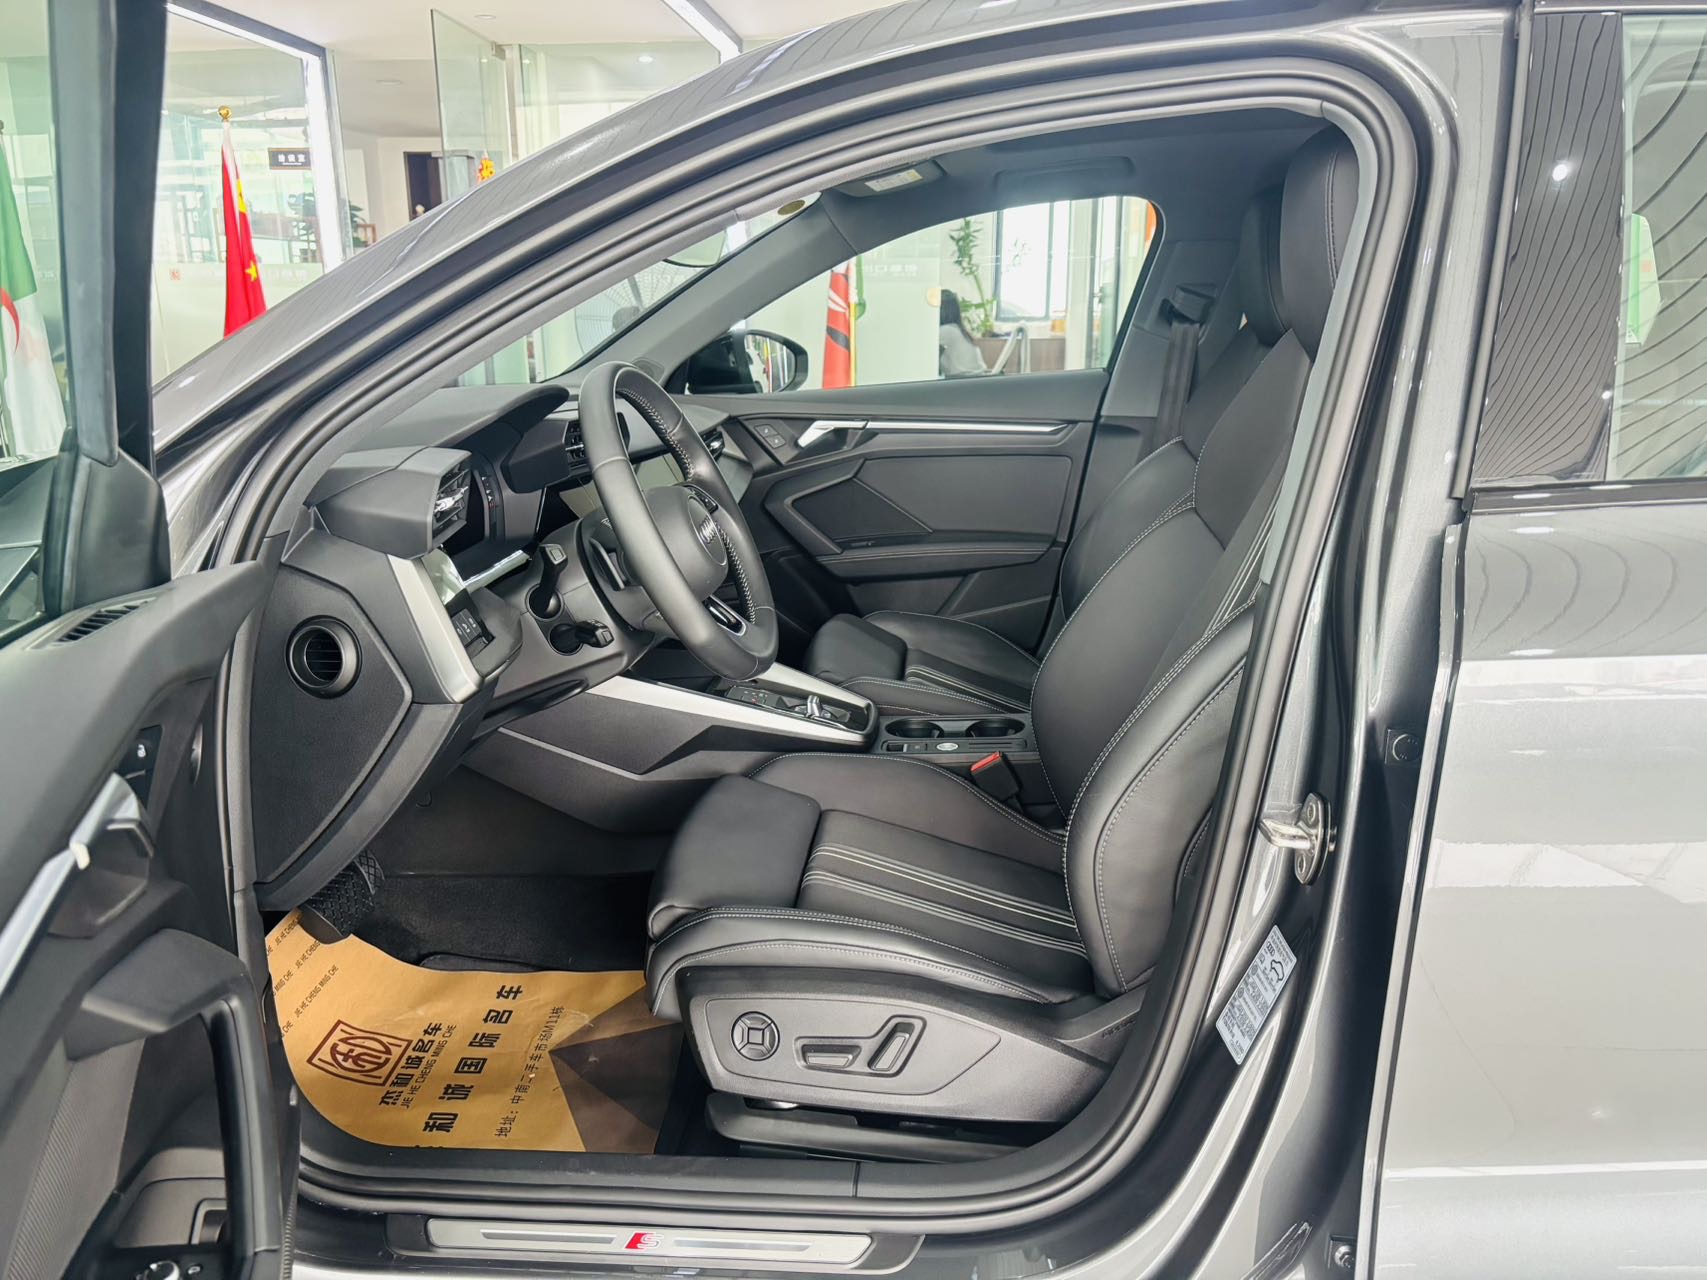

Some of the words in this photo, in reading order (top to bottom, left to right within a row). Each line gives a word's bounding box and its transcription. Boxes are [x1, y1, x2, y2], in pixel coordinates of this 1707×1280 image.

[283, 970, 293, 980] CHE
[300, 953, 308, 962] HE
[294, 1007, 303, 1017] JIE
[300, 1000, 308, 1009] HE
[305, 985, 322, 1003] CHENG
[318, 975, 331, 988] MING
[328, 964, 338, 976] CHE
[282, 1020, 293, 1033] CHE
[379, 1022, 443, 1107] 杰和诚名车
[401, 1096, 413, 1109] JIE
[407, 1083, 421, 1096] HE
[416, 1058, 436, 1084] CHENG
[432, 1039, 448, 1058] MING
[442, 1024, 456, 1040] CHE
[415, 985, 523, 1148] 和诚国际名车
